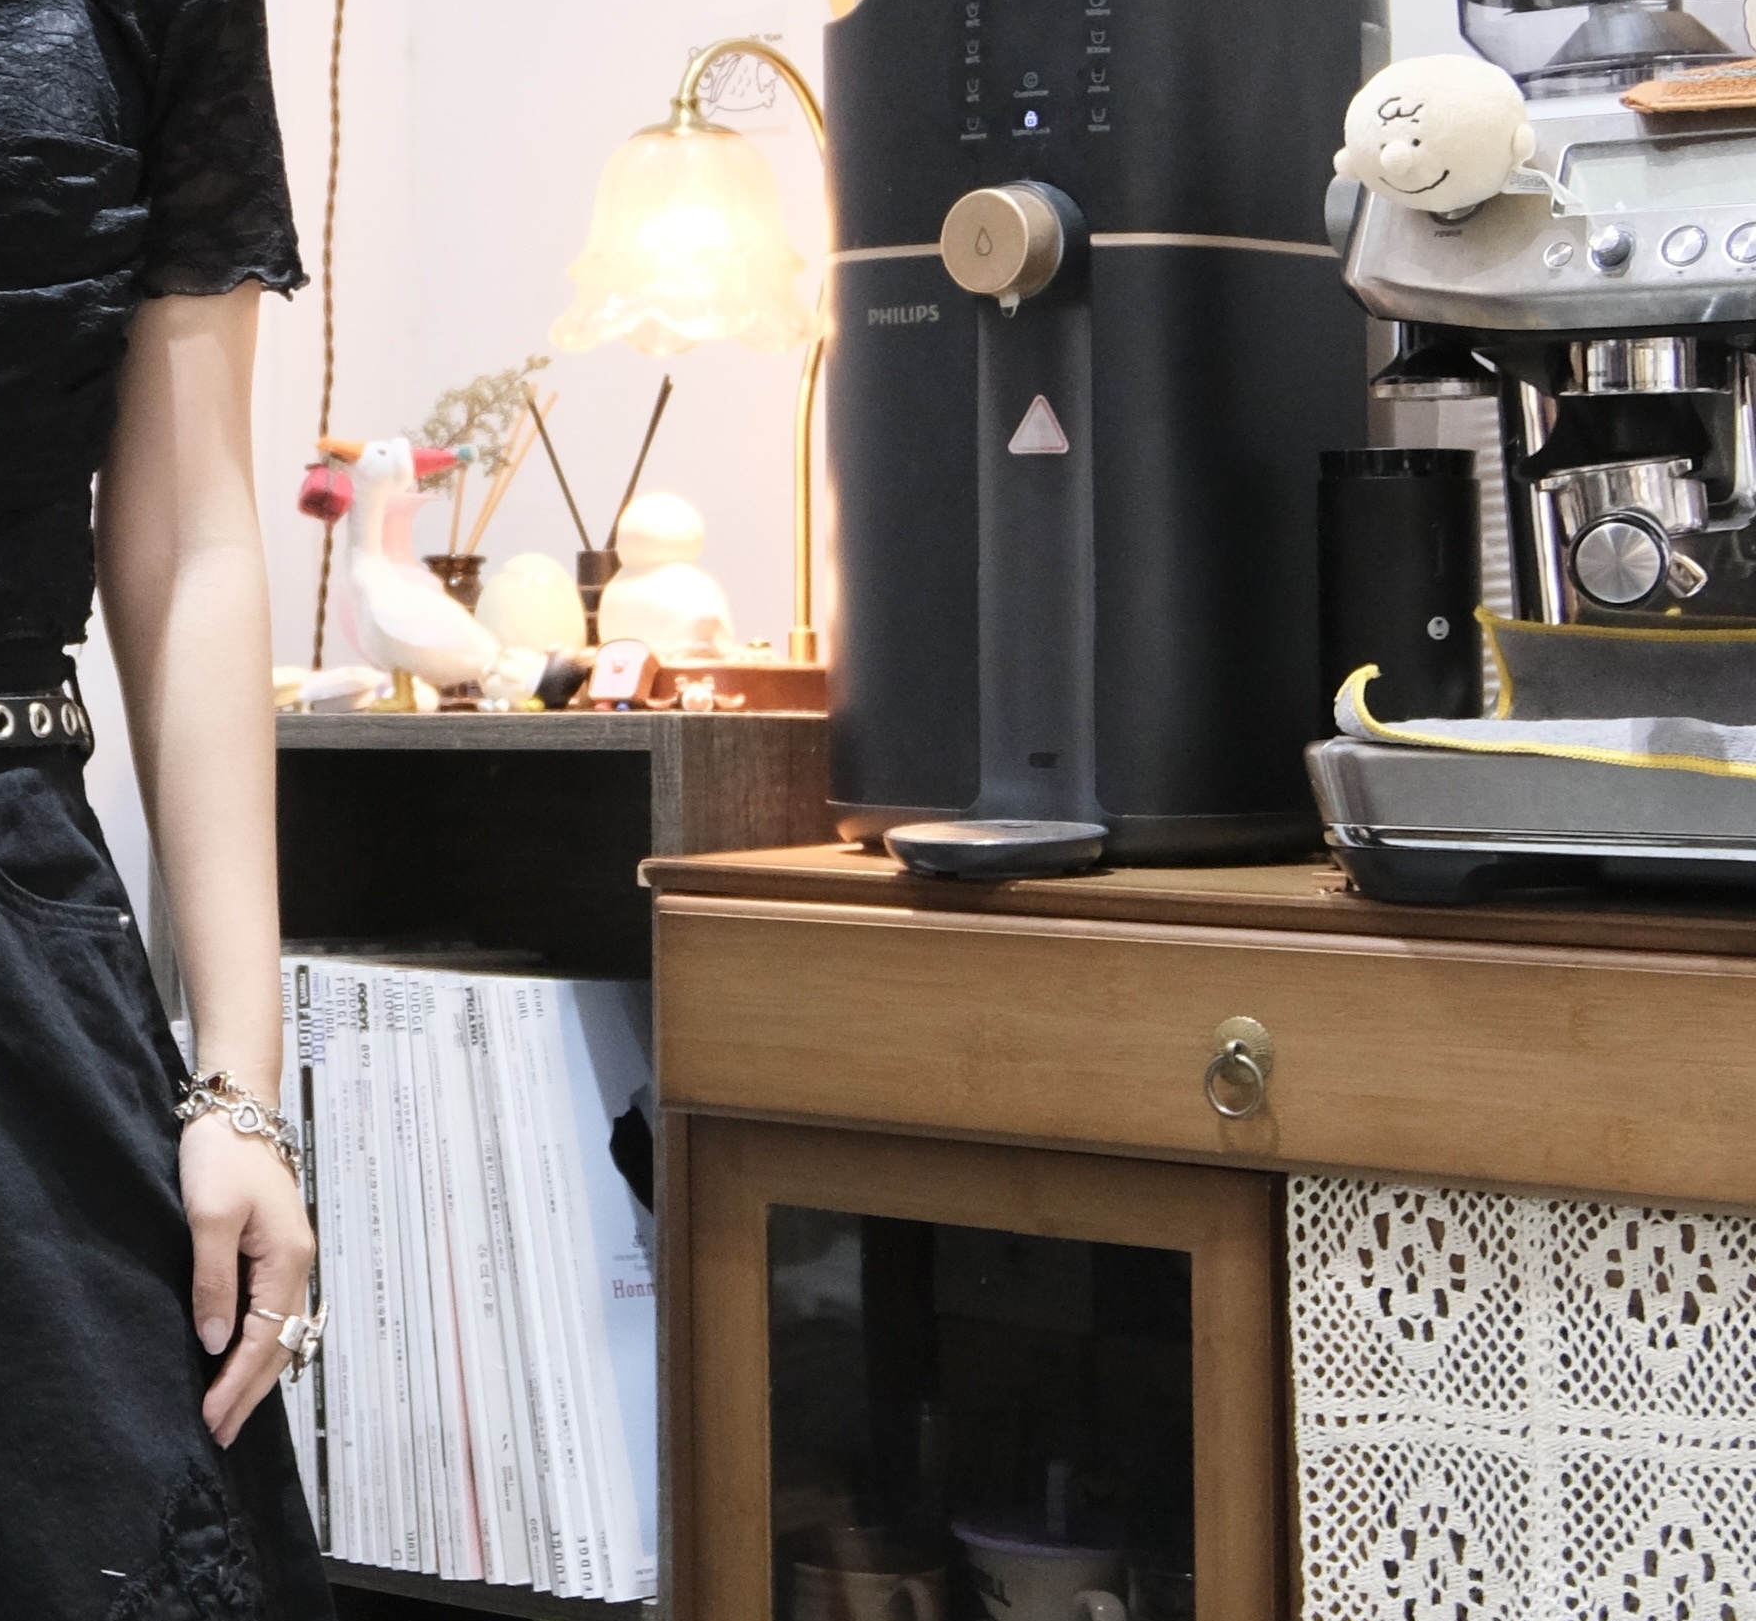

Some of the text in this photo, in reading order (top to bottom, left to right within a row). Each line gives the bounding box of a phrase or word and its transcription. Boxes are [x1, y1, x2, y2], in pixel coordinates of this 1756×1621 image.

[867, 304, 940, 326] PHILIPS
[324, 1000, 335, 1040] FUDGE
[335, 978, 347, 1028] FUDGE
[393, 982, 407, 1033] FUDGE
[408, 981, 423, 1036] FUDGE
[298, 1008, 314, 1067] FUDGE
[310, 1007, 326, 1065] FUDGE
[577, 1536, 594, 1592] FUDGE
